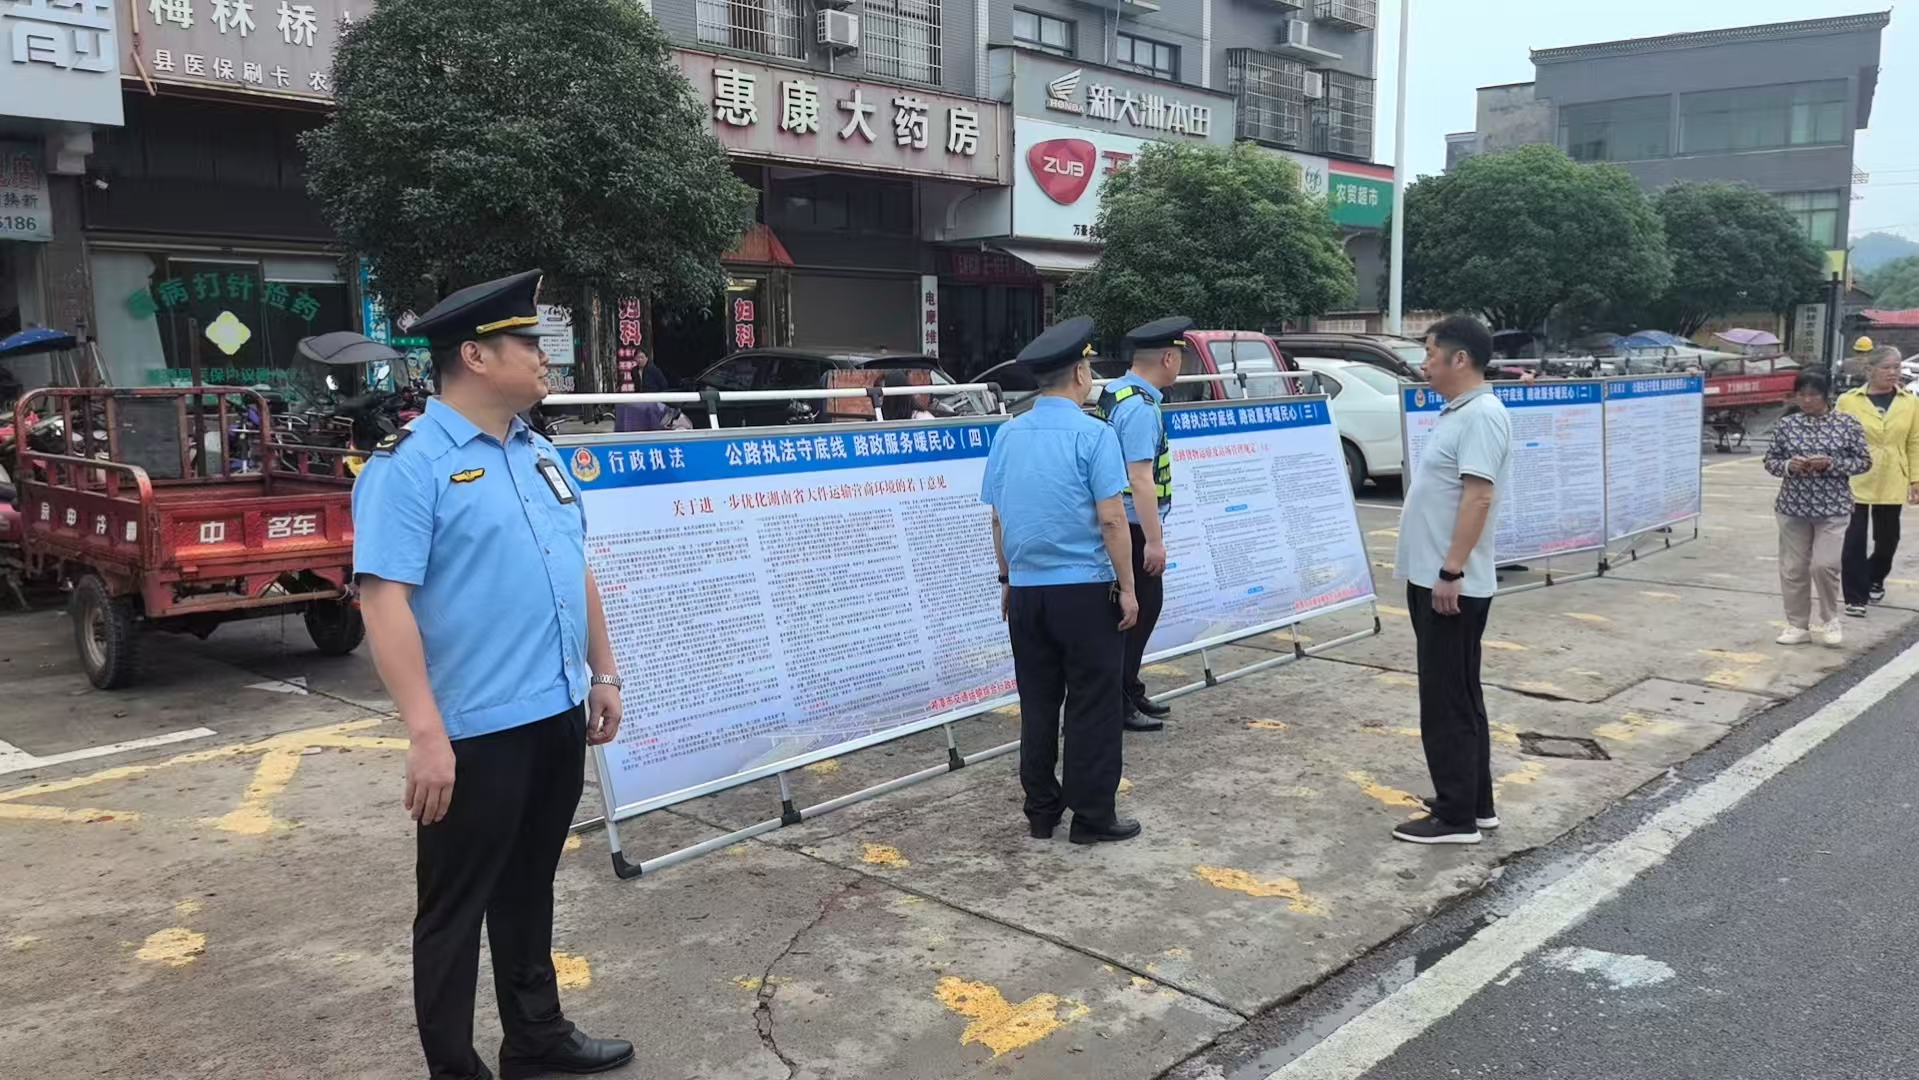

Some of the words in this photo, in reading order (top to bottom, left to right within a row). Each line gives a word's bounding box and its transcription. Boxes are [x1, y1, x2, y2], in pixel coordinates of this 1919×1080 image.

[149, 0, 352, 47] 梅林桥
[153, 49, 290, 87] 县医保刷卡
[712, 67, 981, 157] 惠康大药房
[1050, 99, 1084, 113] HONDA
[1087, 83, 1212, 137] 新大洲本田
[1043, 156, 1085, 177] ZUB
[1336, 183, 1379, 207] 农贸超市
[735, 297, 755, 348] 妇科
[1172, 409, 1237, 431] 公路执法守底线
[608, 447, 685, 474] 行政执法
[725, 437, 847, 466] 公路执法守底线
[672, 475, 947, 517] 关于进一步优化湖南省大件运输营商环境的若干意见
